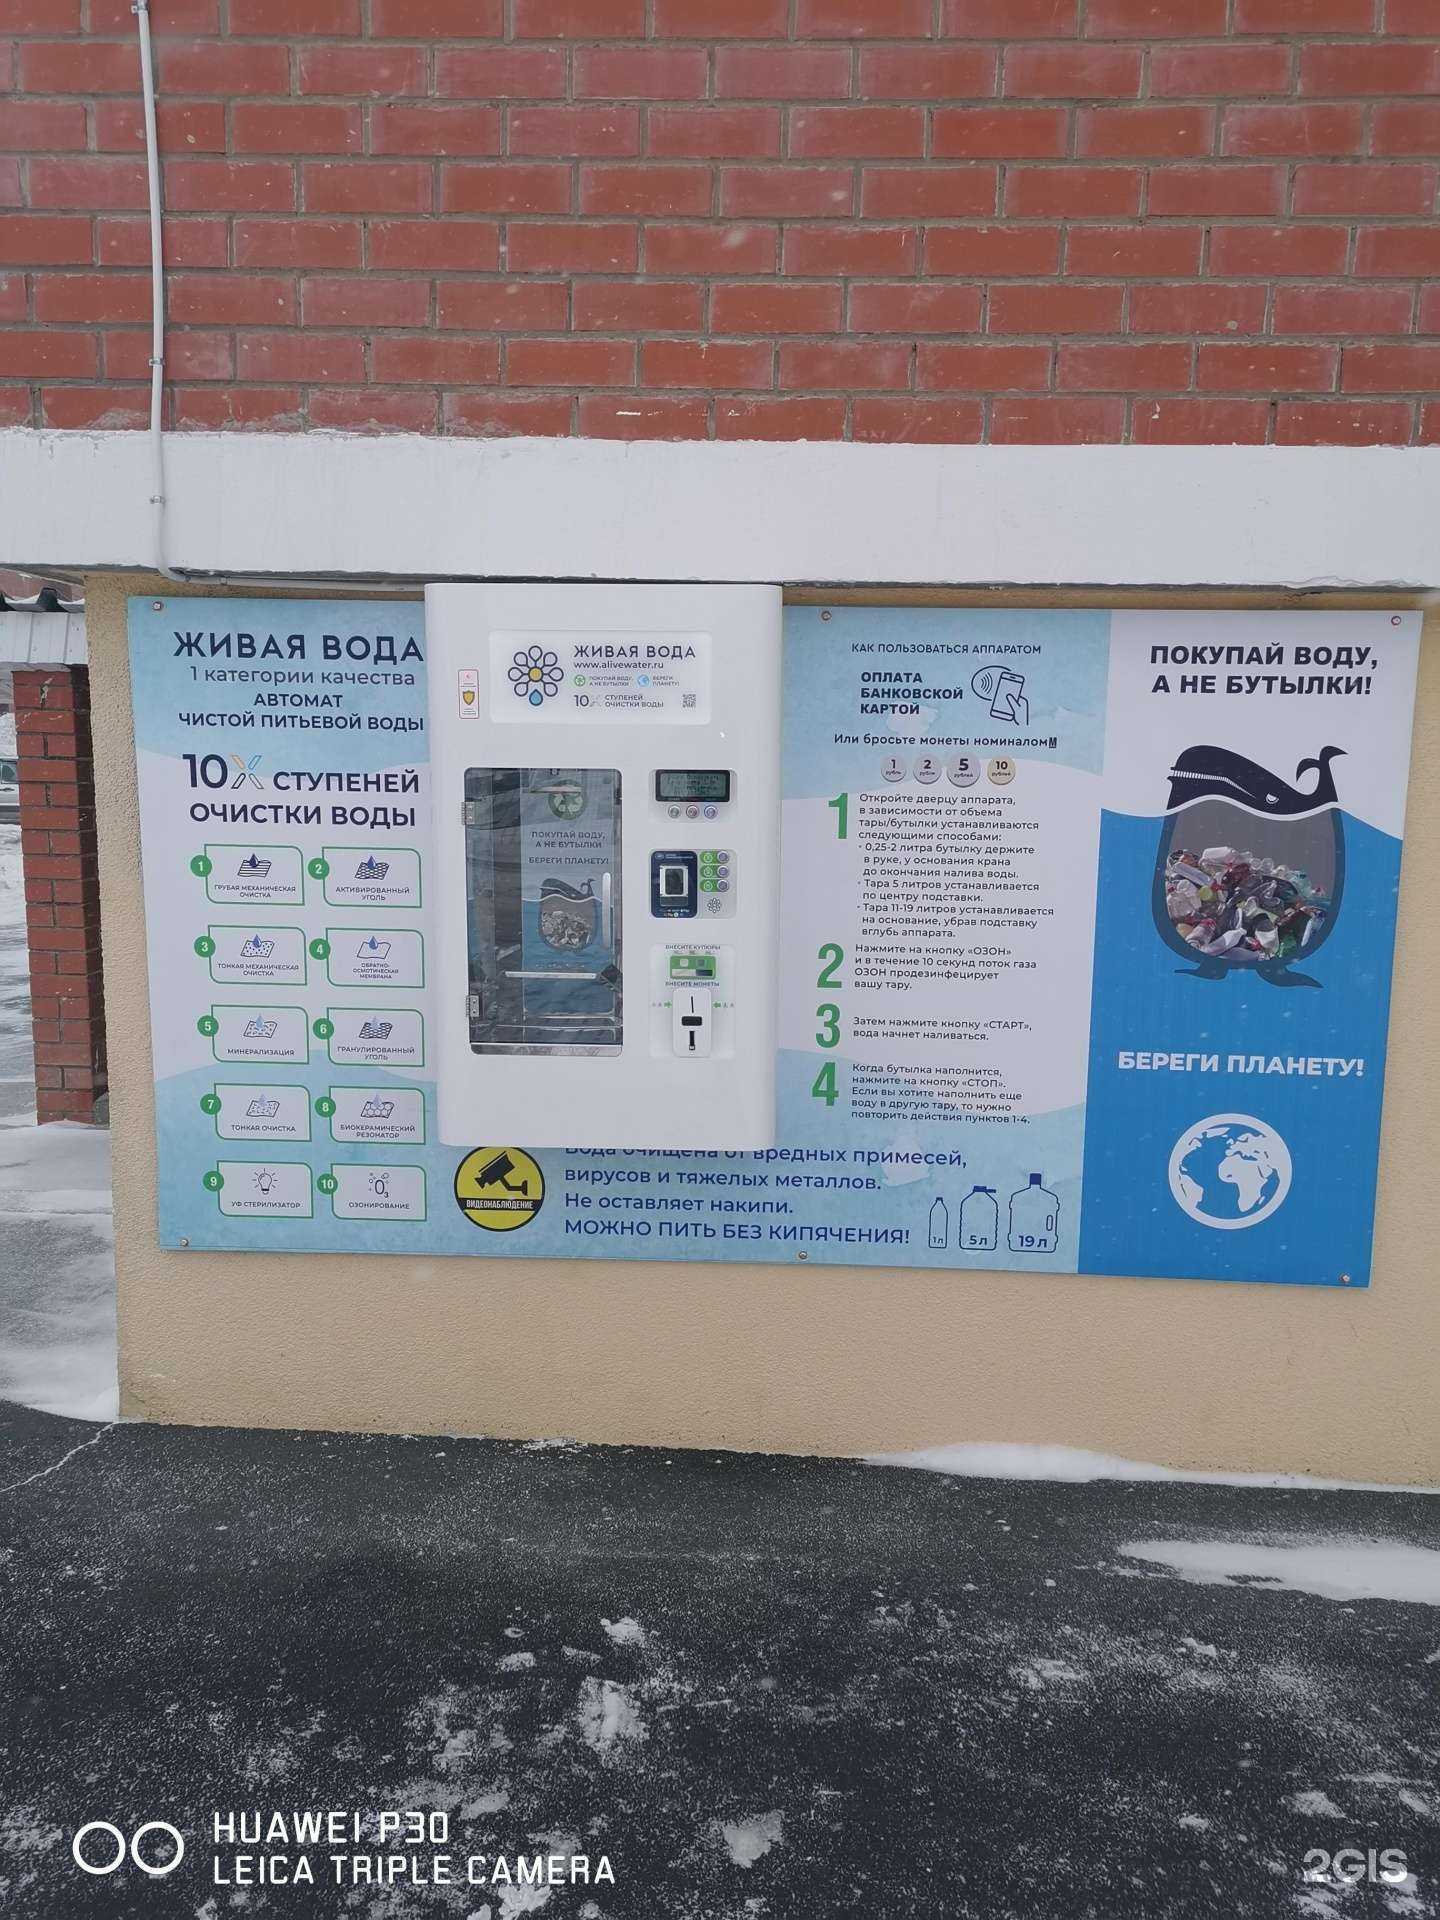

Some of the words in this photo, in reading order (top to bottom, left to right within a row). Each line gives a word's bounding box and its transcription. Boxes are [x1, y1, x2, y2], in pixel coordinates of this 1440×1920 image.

[174, 632, 305, 659] ЖИВАЯ
[323, 636, 424, 664] ВОДА
[574, 645, 638, 657] ЖИВАЯ
[647, 646, 695, 659] ВОДА
[852, 643, 874, 652] КАК
[879, 644, 968, 654] ПОЛЬЗОВАТЬСЯ
[973, 645, 1041, 654] АППАРАТОМ
[1150, 642, 1284, 665] ПОКУПАЙ
[1295, 647, 1378, 669] ВОДУ,
[574, 661, 663, 669] www.alivewater.ru
[205, 668, 313, 685] категории
[321, 670, 415, 685] качества
[861, 672, 922, 683] ОПЛАТА
[1152, 675, 1170, 693] А
[1181, 675, 1216, 693] НЕ
[1226, 676, 1371, 694] БУТЫЛКИ!
[861, 687, 962, 699] БАНКОВСКОЙ
[254, 694, 343, 707] АВТОМАТ
[860, 701, 919, 714] КАРТОЙ
[179, 710, 254, 727] ЧИСТОЙ
[261, 711, 361, 729] ПИТЬЕВОЙ
[368, 716, 423, 732] ВОДЫ
[835, 734, 859, 744] Или
[864, 735, 915, 747] бросьте
[920, 737, 969, 746] монеты
[959, 759, 968, 771] 5
[274, 770, 419, 793] СТУПЕНЕЙ
[190, 803, 321, 824] ОЧИСТКИ
[332, 806, 415, 829] ВОДЫ
[828, 793, 848, 839] 1
[860, 794, 912, 804] Откройте
[917, 795, 957, 804] дверцу
[961, 797, 1016, 805] аппарата,
[869, 808, 941, 816] зависимости
[961, 808, 1002, 817] объема
[859, 819, 937, 829] тары/бутылки
[941, 822, 1039, 830] устанавливаются
[859, 832, 933, 841] следующими
[937, 832, 1002, 841] способами:
[901, 845, 932, 854] литра
[936, 843, 982, 855] бутылку
[985, 846, 1034, 855] держите
[874, 857, 900, 866] руке,
[914, 857, 973, 865] основания
[881, 869, 940, 877] окончания
[865, 879, 890, 889] Тара
[901, 881, 941, 890] литров
[944, 883, 1039, 891] устанавливается
[880, 893, 919, 901] центру
[922, 893, 982, 902] подставки.
[864, 904, 888, 913] Тара
[891, 904, 913, 912] 11-19
[916, 905, 956, 914] литров
[960, 907, 1054, 915] устанавливается
[878, 917, 941, 926] основание,
[944, 916, 976, 926] убрав
[980, 919, 1037, 928] подставку
[862, 928, 898, 937] вглубь
[902, 929, 955, 938] аппарата.
[817, 943, 844, 989] 2
[856, 944, 906, 953] Нажмите
[926, 947, 965, 956] кнопку
[968, 948, 1011, 956] «ОЗОН»
[937, 959, 975, 967] секунд
[1014, 960, 1036, 968] газа
[855, 968, 887, 976] ОЗОН
[890, 969, 999, 980] продезинфецирует
[854, 982, 882, 990] вашу
[886, 982, 912, 990] тару.
[816, 1003, 840, 1048] 3
[854, 1017, 886, 1026] Затем
[942, 1020, 980, 1029] кнопку
[983, 1020, 1032, 1030] «СТАРТ»,
[853, 1029, 879, 1038] вода
[882, 1030, 920, 1038] начнет
[923, 1031, 988, 1040] наливаться.
[1118, 1052, 1218, 1071] БЕРЕГИ
[1228, 1056, 1364, 1076] ПЛАНЕТУ!
[812, 1062, 839, 1106] 4
[852, 1064, 883, 1073] Когда
[887, 1063, 932, 1075] бутылка
[935, 1066, 1001, 1077] наполнится,
[852, 1077, 900, 1085] нажмите
[920, 1079, 958, 1087] кнопку
[962, 1079, 1006, 1087] «СТОП».
[852, 1087, 878, 1096] Если
[899, 1089, 934, 1097] хотите
[937, 1090, 996, 1098] наполнить
[1000, 1092, 1022, 1100] еще
[852, 1100, 877, 1108] воду
[889, 1101, 929, 1110] другую
[933, 1102, 958, 1110] тару,
[976, 1103, 1011, 1111] нужно
[852, 1112, 907, 1120] повторить
[911, 1111, 961, 1122] действия
[965, 1115, 1009, 1123] пунктов
[753, 1149, 847, 1162] вредных
[854, 1150, 967, 1168] примесей,
[566, 1169, 650, 1185] вирусов
[658, 1170, 670, 1182] и
[677, 1171, 768, 1187] тяжелых
[776, 1176, 881, 1190] металлов.
[466, 1200, 534, 1210] ВИДЕОНАБЛЮДЕНИЕ
[566, 1193, 592, 1208] Не
[599, 1196, 702, 1210] оставляет
[710, 1199, 794, 1214] накипи.
[566, 1220, 650, 1235] МОЖНО
[659, 1222, 716, 1238] ПИТЬ
[723, 1224, 761, 1239] БЕЗ
[769, 1225, 909, 1244] КИПЯЧЕНИЯ!
[979, 1237, 987, 1246] л
[1018, 1235, 1034, 1247] 19
[1036, 1238, 1047, 1248] л
